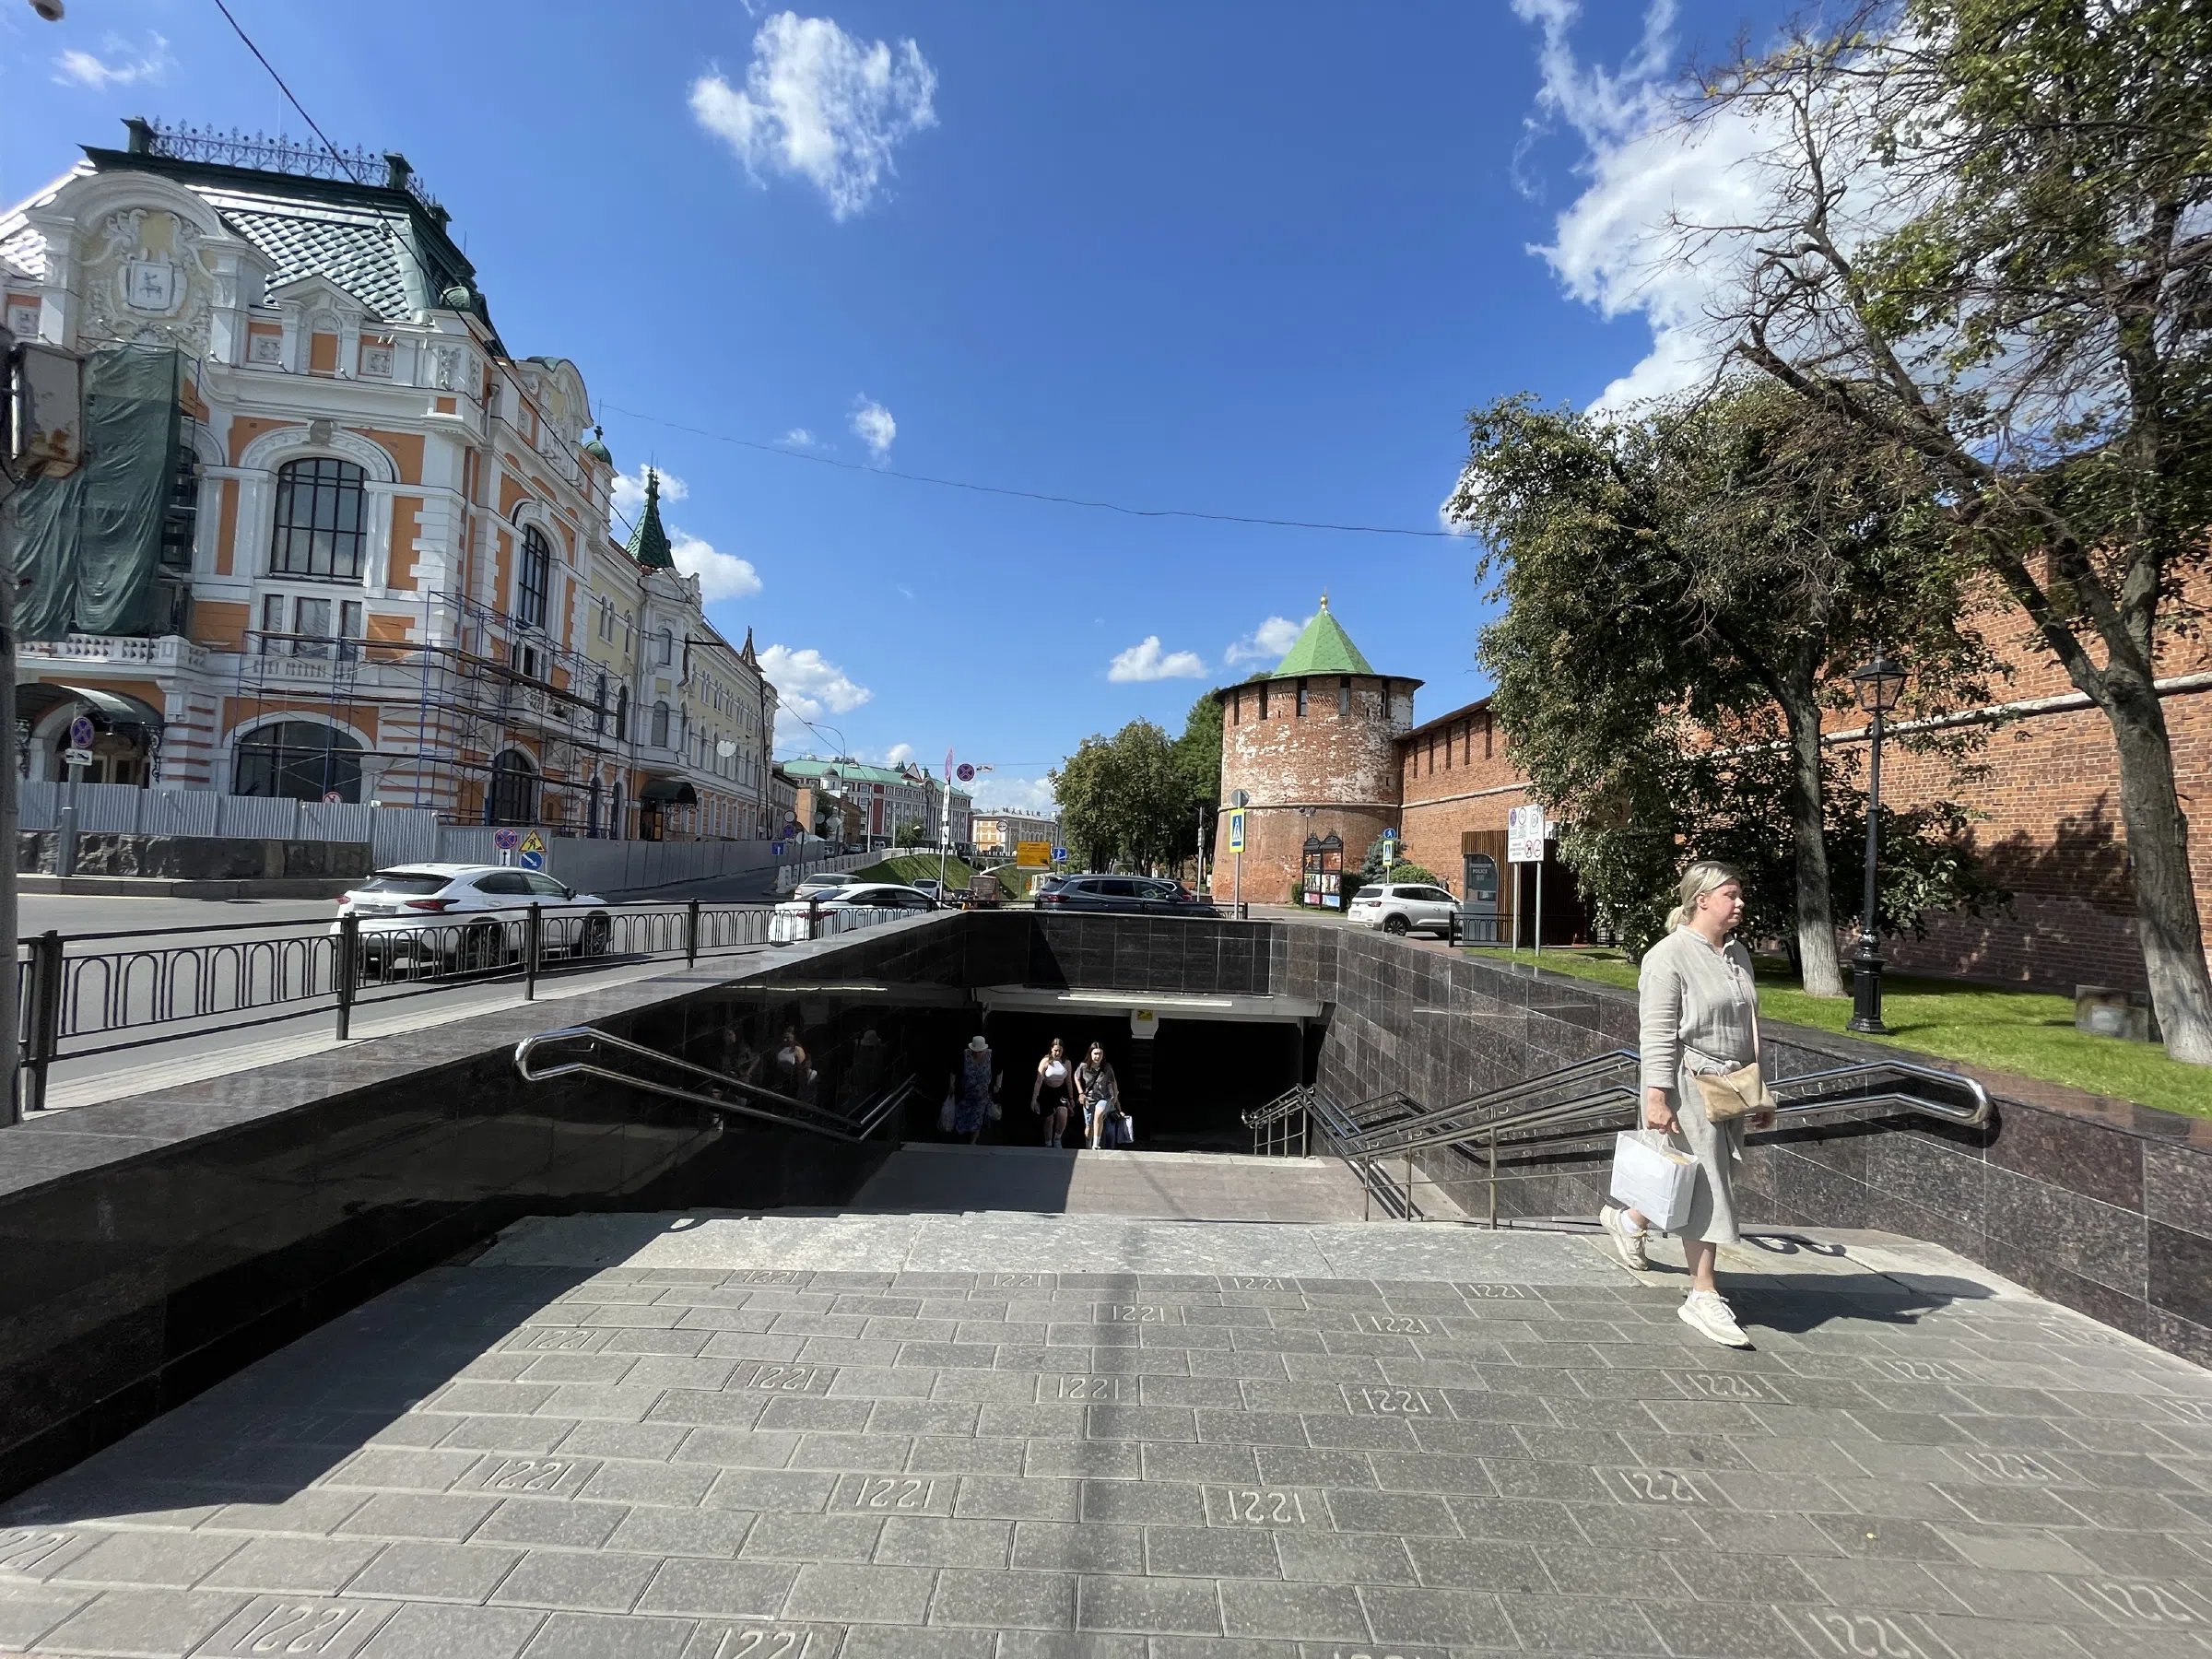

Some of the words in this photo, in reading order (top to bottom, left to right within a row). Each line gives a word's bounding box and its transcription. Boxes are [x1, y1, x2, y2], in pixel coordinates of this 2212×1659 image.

[991, 1274, 1041, 1288] 1221
[1233, 1277, 1285, 1290] 1221
[1469, 1284, 1525, 1299] 1221
[1112, 1305, 1165, 1322] 1221
[1371, 1316, 1430, 1334] 1221
[524, 1329, 599, 1349] 1221
[745, 1365, 818, 1391] 1221
[1883, 1360, 1963, 1382] 1221
[1056, 1376, 1119, 1400] 1221
[1687, 1372, 1763, 1397] 1221
[1361, 1387, 1431, 1415] 1221
[478, 1459, 576, 1491] 1221
[1965, 1451, 2064, 1481] 1221
[854, 1477, 935, 1508] 1221
[1618, 1471, 1714, 1506] 1221
[1227, 1489, 1306, 1524] 1221
[2076, 1577, 2211, 1624] 1221
[229, 1604, 365, 1653] 1221
[1807, 1611, 1932, 1659] 1221
